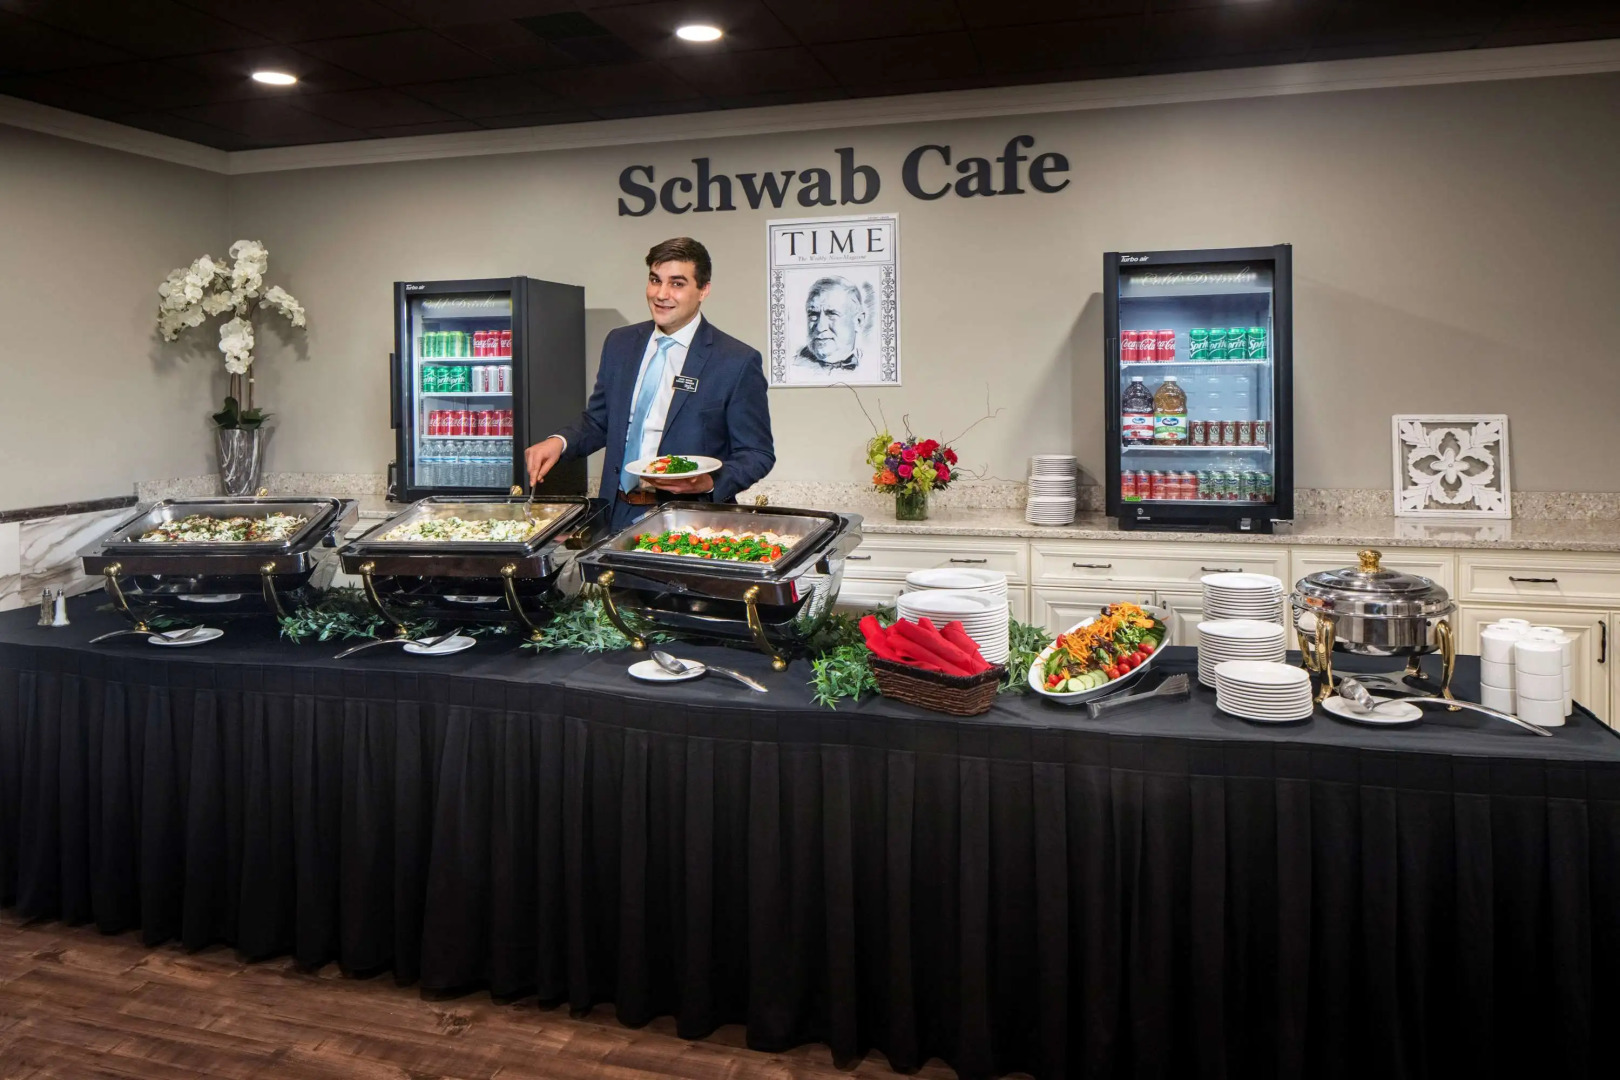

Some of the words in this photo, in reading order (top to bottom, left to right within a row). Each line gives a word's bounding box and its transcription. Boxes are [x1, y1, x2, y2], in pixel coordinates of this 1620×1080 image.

[618, 147, 881, 217] Schwab
[902, 134, 1071, 201] Cafe
[782, 228, 884, 256] TIME
[1120, 255, 1139, 263] Turbo
